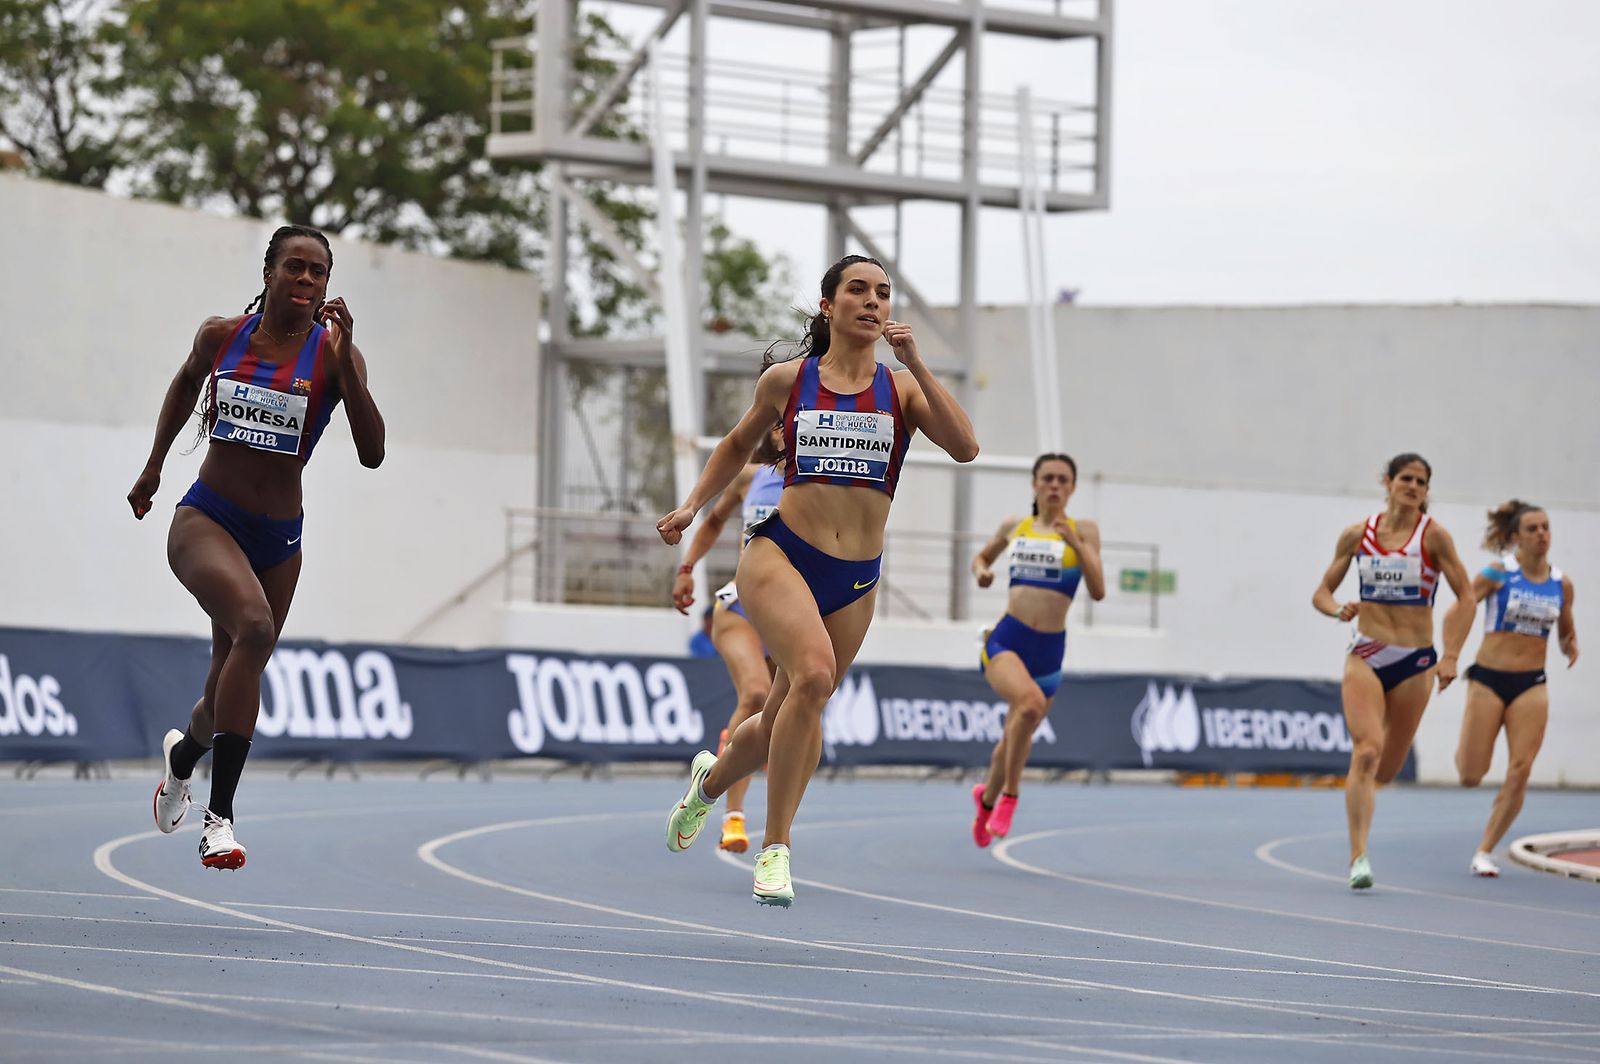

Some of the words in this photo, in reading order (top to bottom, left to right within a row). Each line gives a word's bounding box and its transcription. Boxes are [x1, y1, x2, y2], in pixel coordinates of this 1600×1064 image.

[260, 397, 287, 408] HUELVA
[219, 401, 299, 430] BOKESA
[847, 421, 877, 429] HUELVA
[799, 435, 890, 453] SANTIDRIAN
[1375, 572, 1402, 581] BOU
[256, 648, 413, 740] oma
[881, 699, 1058, 744] IBERDROA
